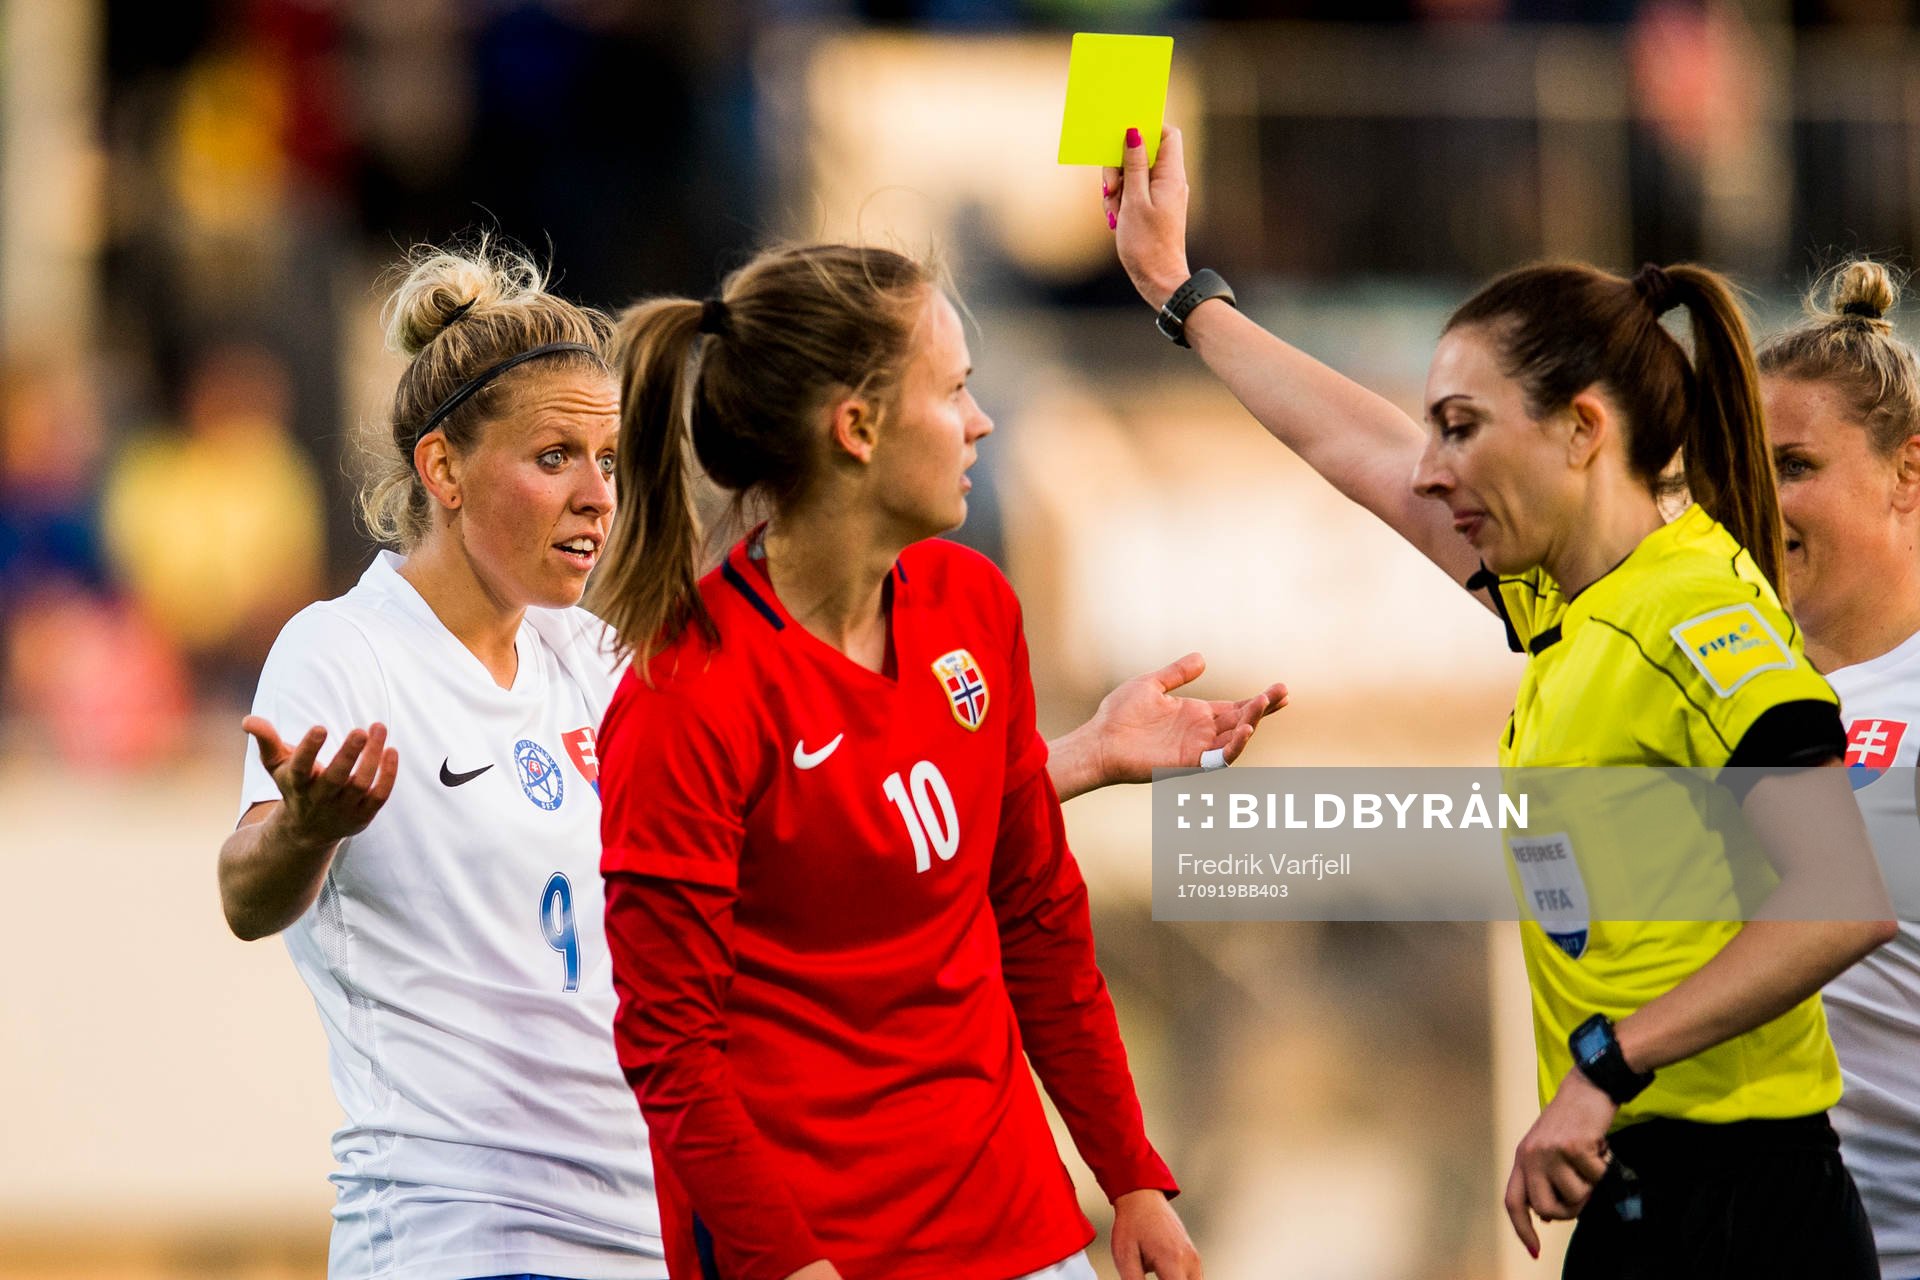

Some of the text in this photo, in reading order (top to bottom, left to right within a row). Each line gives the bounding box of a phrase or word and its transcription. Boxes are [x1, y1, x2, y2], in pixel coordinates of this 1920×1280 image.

[1699, 633, 1740, 656] FIFA
[883, 761, 960, 873] 10
[539, 871, 582, 993] 9
[1534, 888, 1574, 911] FIFA
